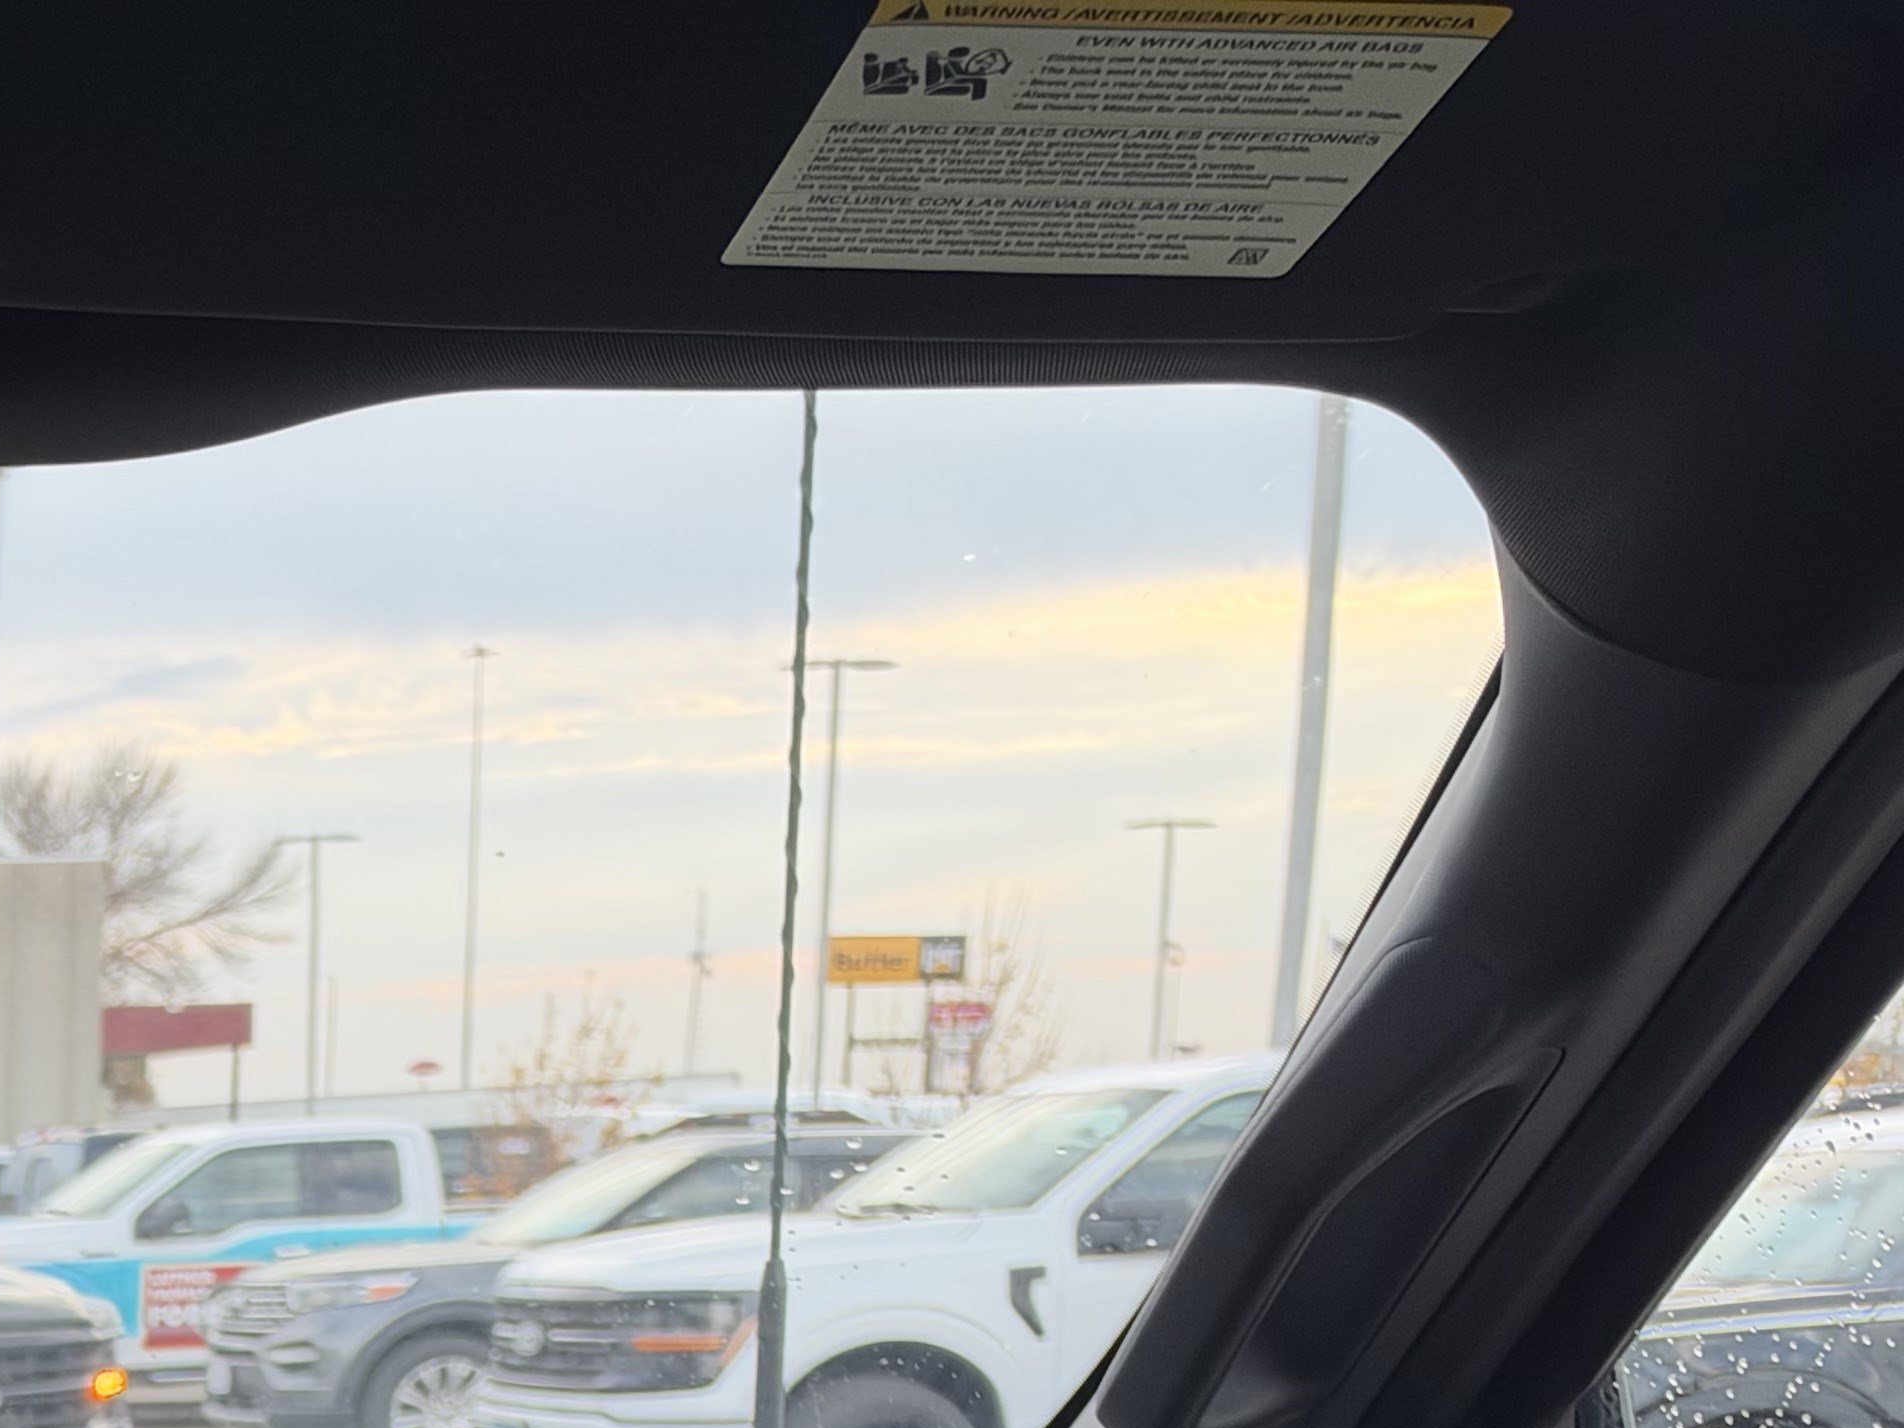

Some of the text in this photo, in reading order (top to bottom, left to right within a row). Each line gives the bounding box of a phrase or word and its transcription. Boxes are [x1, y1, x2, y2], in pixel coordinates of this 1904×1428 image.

[1077, 36, 1423, 55] EVEN WITH ADVANCED AIR BAGS
[901, 124, 957, 138] AVEC
